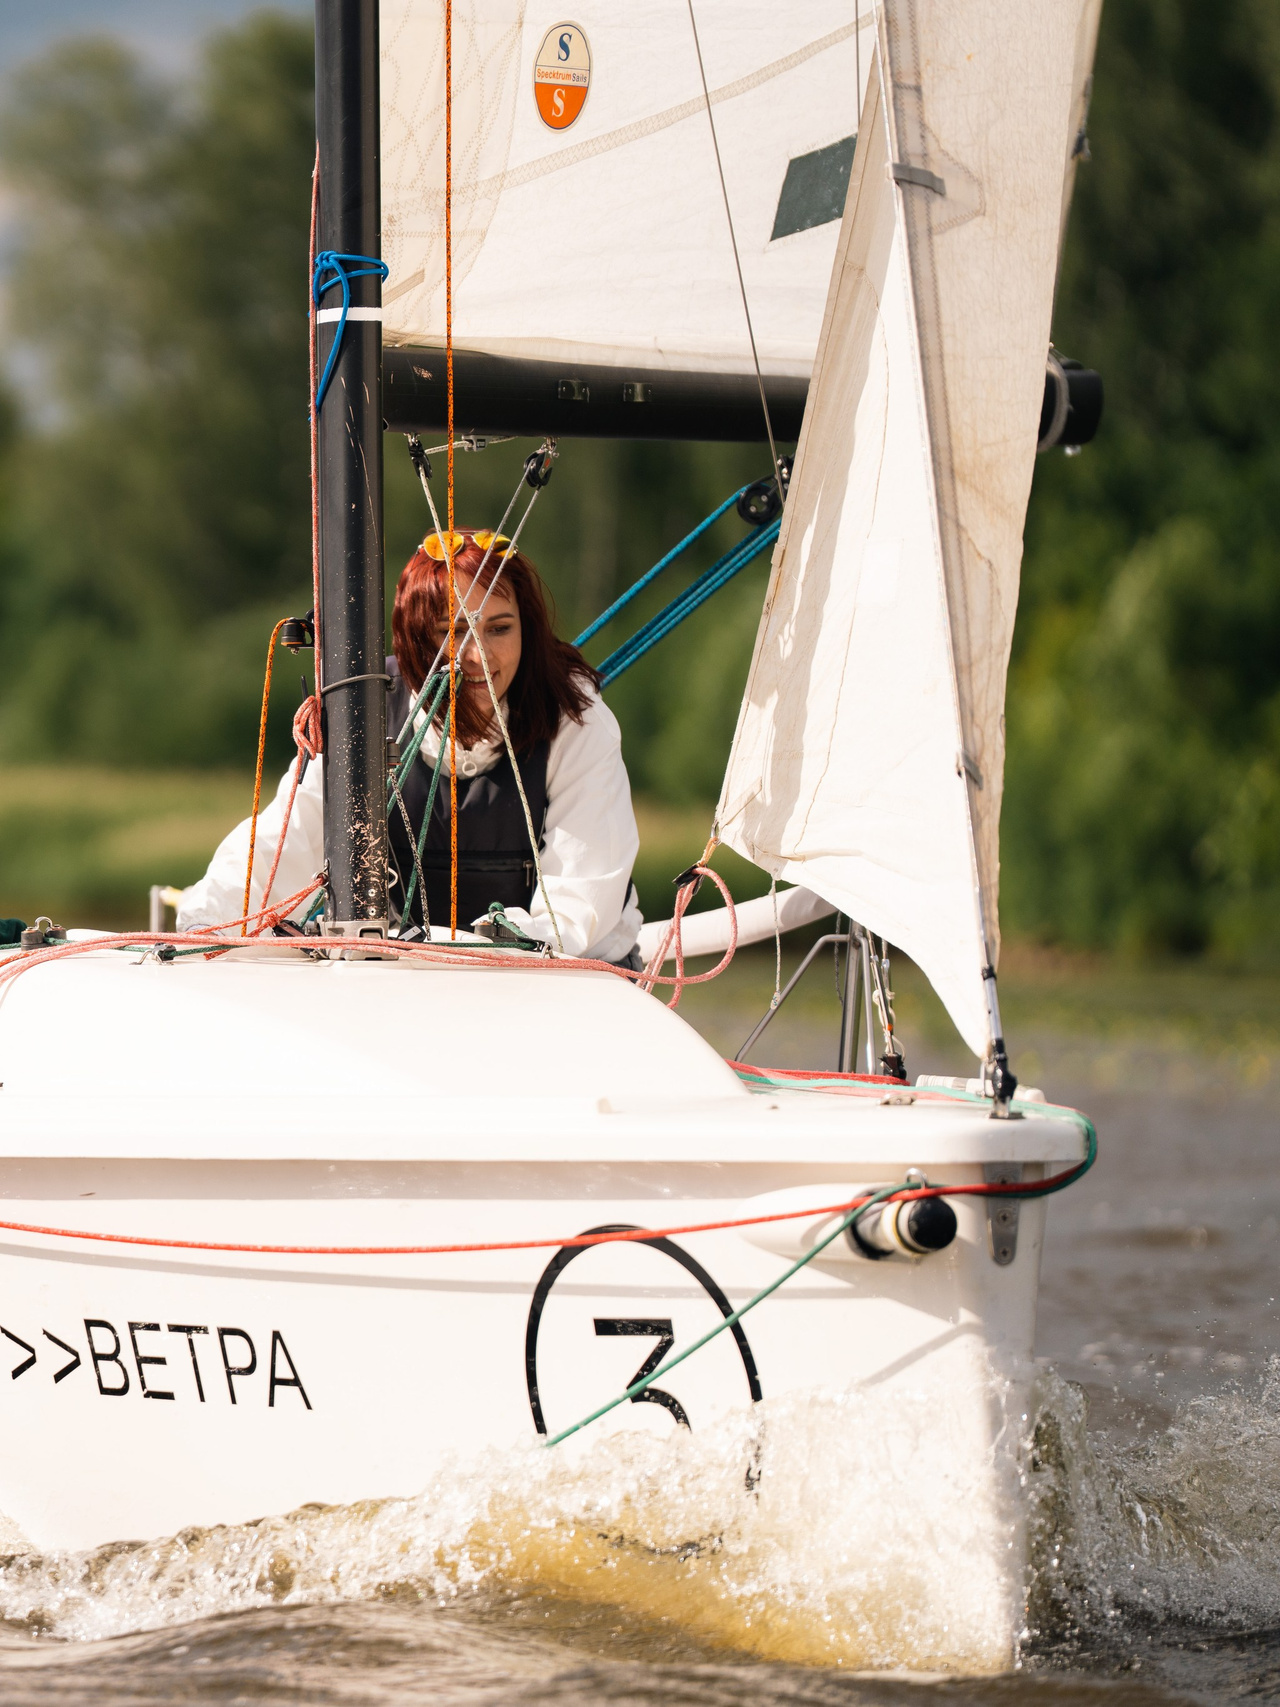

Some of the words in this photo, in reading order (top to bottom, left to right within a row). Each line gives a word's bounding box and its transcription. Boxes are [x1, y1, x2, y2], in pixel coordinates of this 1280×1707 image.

[558, 33, 572, 61] S
[552, 88, 566, 117] S
[593, 1318, 693, 1434] 3
